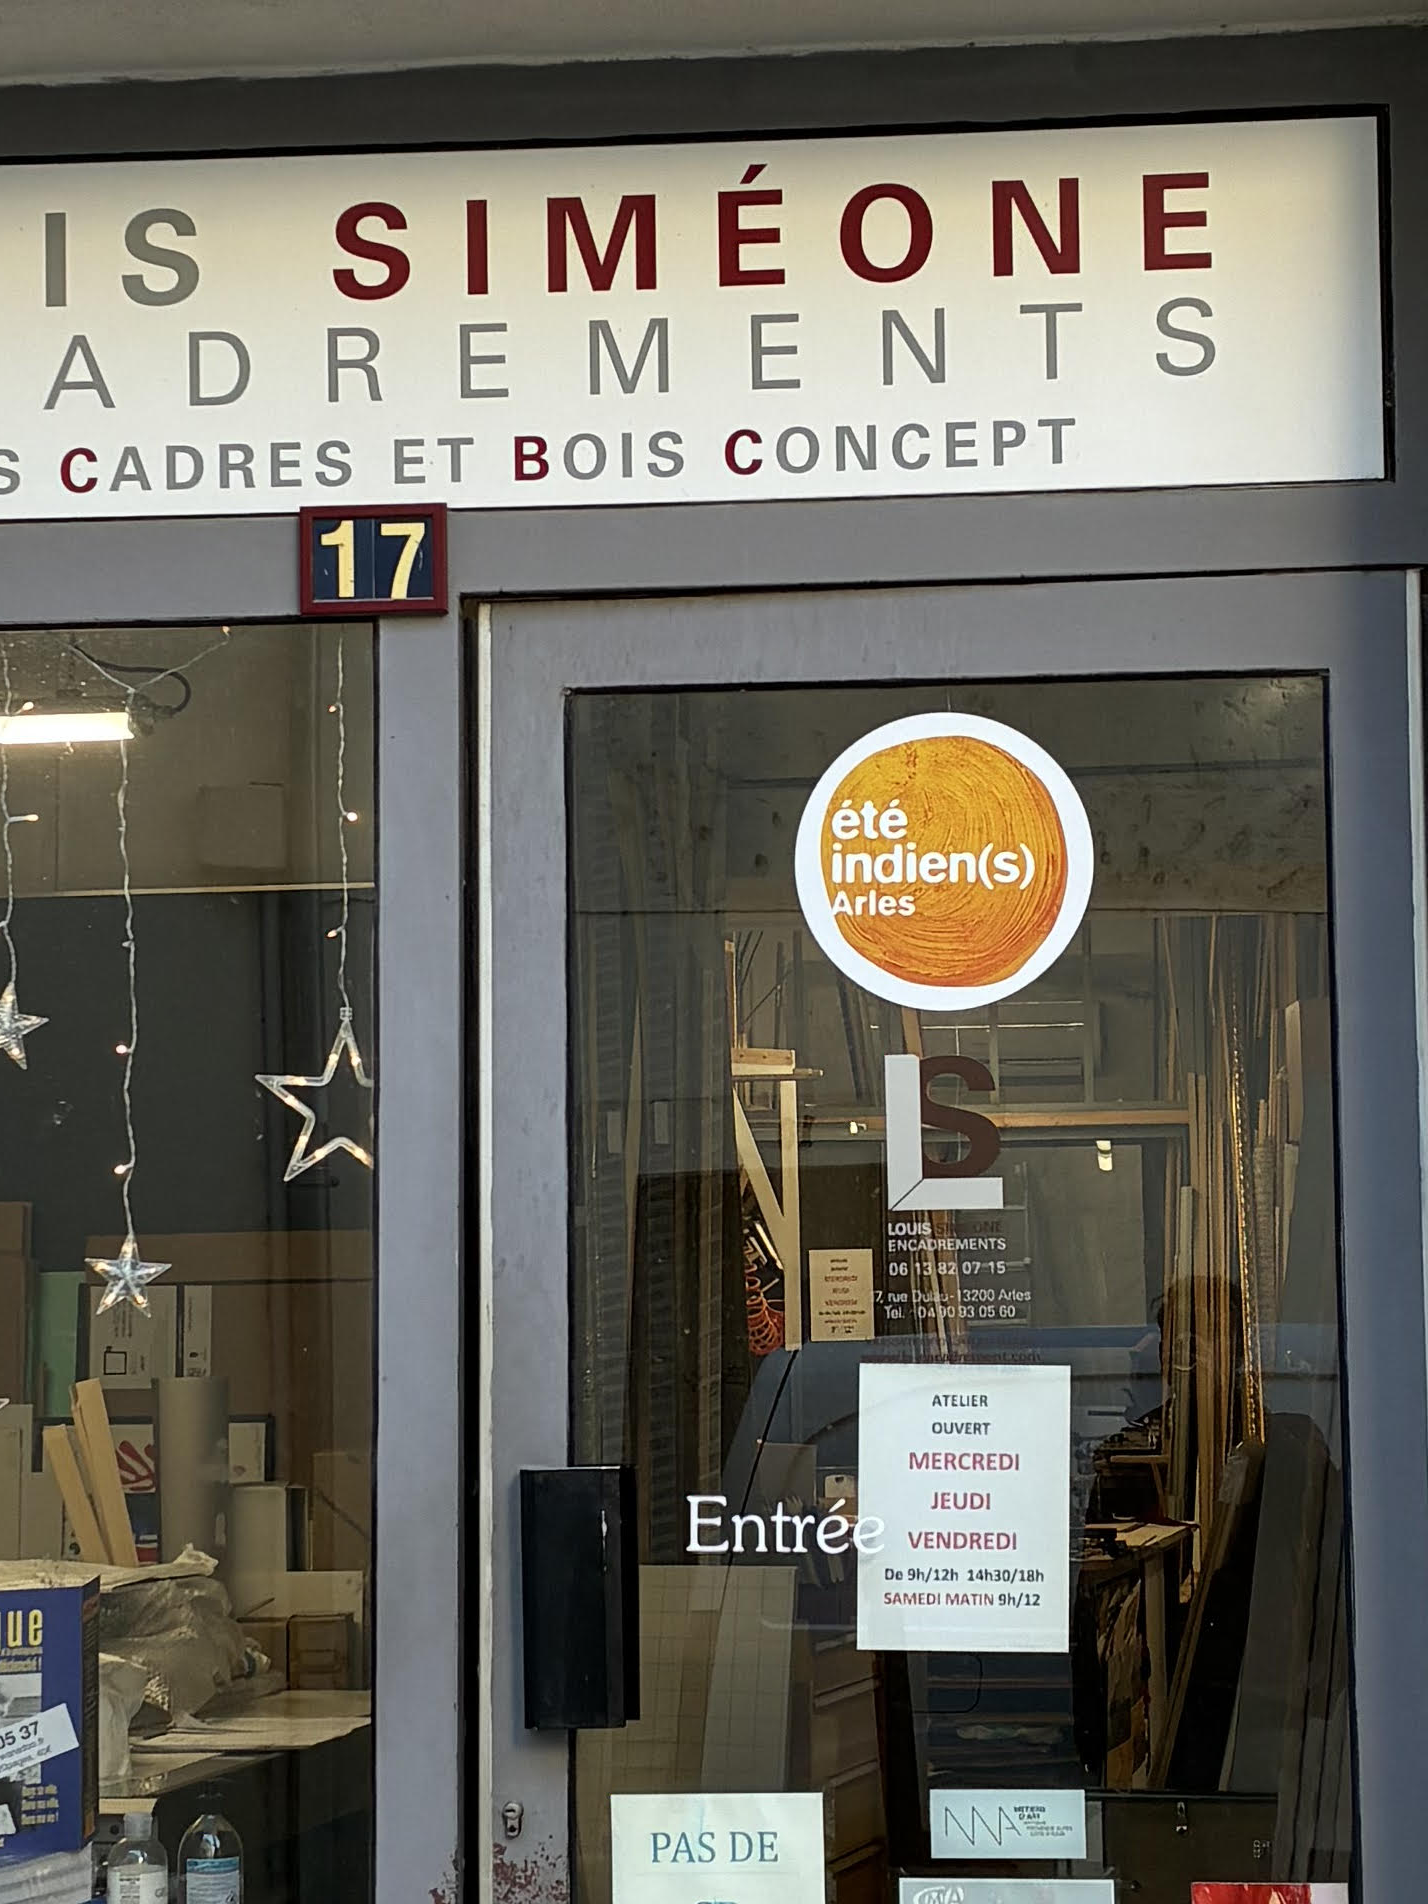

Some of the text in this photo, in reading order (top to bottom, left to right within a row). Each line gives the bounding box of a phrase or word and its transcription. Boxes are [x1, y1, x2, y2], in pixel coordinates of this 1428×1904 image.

[331, 162, 1215, 301] SIMÉONE
[59, 439, 353, 495] CADRES
[393, 435, 476, 486] ET
[513, 430, 687, 483] BOIS
[723, 416, 1077, 476] CONCEPT
[318, 518, 428, 601] 17
[831, 798, 908, 840] été
[831, 842, 1036, 890] indien(s)
[831, 889, 917, 917] Arles
[887, 1222, 932, 1236] LOUIS
[887, 1237, 1007, 1253] ENCADREMENTS
[888, 1260, 1006, 1276] 06 13 82 07 15
[887, 1291, 908, 1303] rue
[997, 1287, 1032, 1302] Arles
[978, 1305, 996, 1318] 05
[998, 1305, 1016, 1318] 60
[931, 1394, 989, 1409] ATELIER
[931, 1421, 990, 1436] OUVERT
[908, 1451, 1020, 1472] MERCREDI
[930, 1491, 991, 1511] JEUDI
[685, 1494, 885, 1555] Entrée
[908, 1530, 1018, 1551] VENDREDI
[884, 1567, 1044, 1585] De 9h/12h 14h30/18h
[884, 1591, 1041, 1609] SAMEDI MATIN 9h/12
[19, 1720, 39, 1740] 37
[650, 1830, 779, 1864] PAS DE
